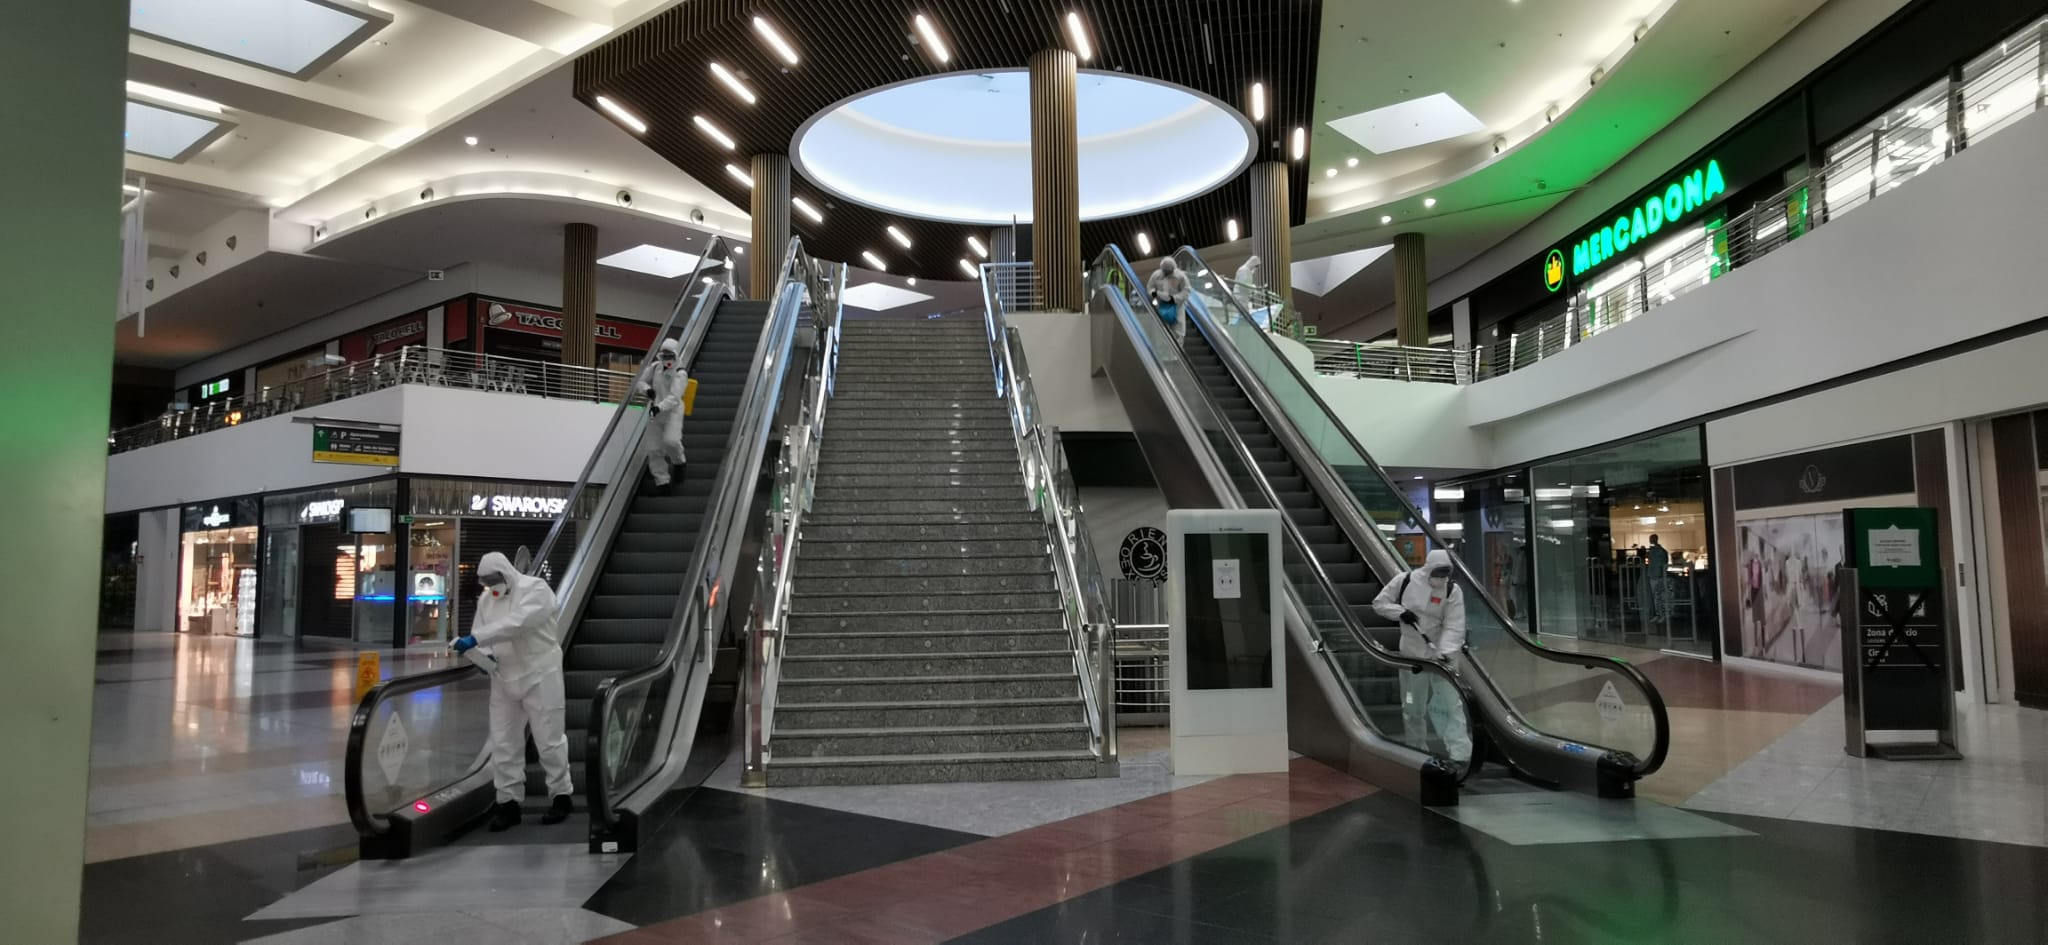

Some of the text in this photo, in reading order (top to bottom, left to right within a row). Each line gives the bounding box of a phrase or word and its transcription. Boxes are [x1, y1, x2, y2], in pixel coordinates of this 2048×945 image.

[1573, 159, 1725, 276] MERCADONA
[491, 496, 568, 513] SWAROVSK
[1120, 528, 1168, 558] ORIEN
[1867, 628, 1886, 637] Zona
